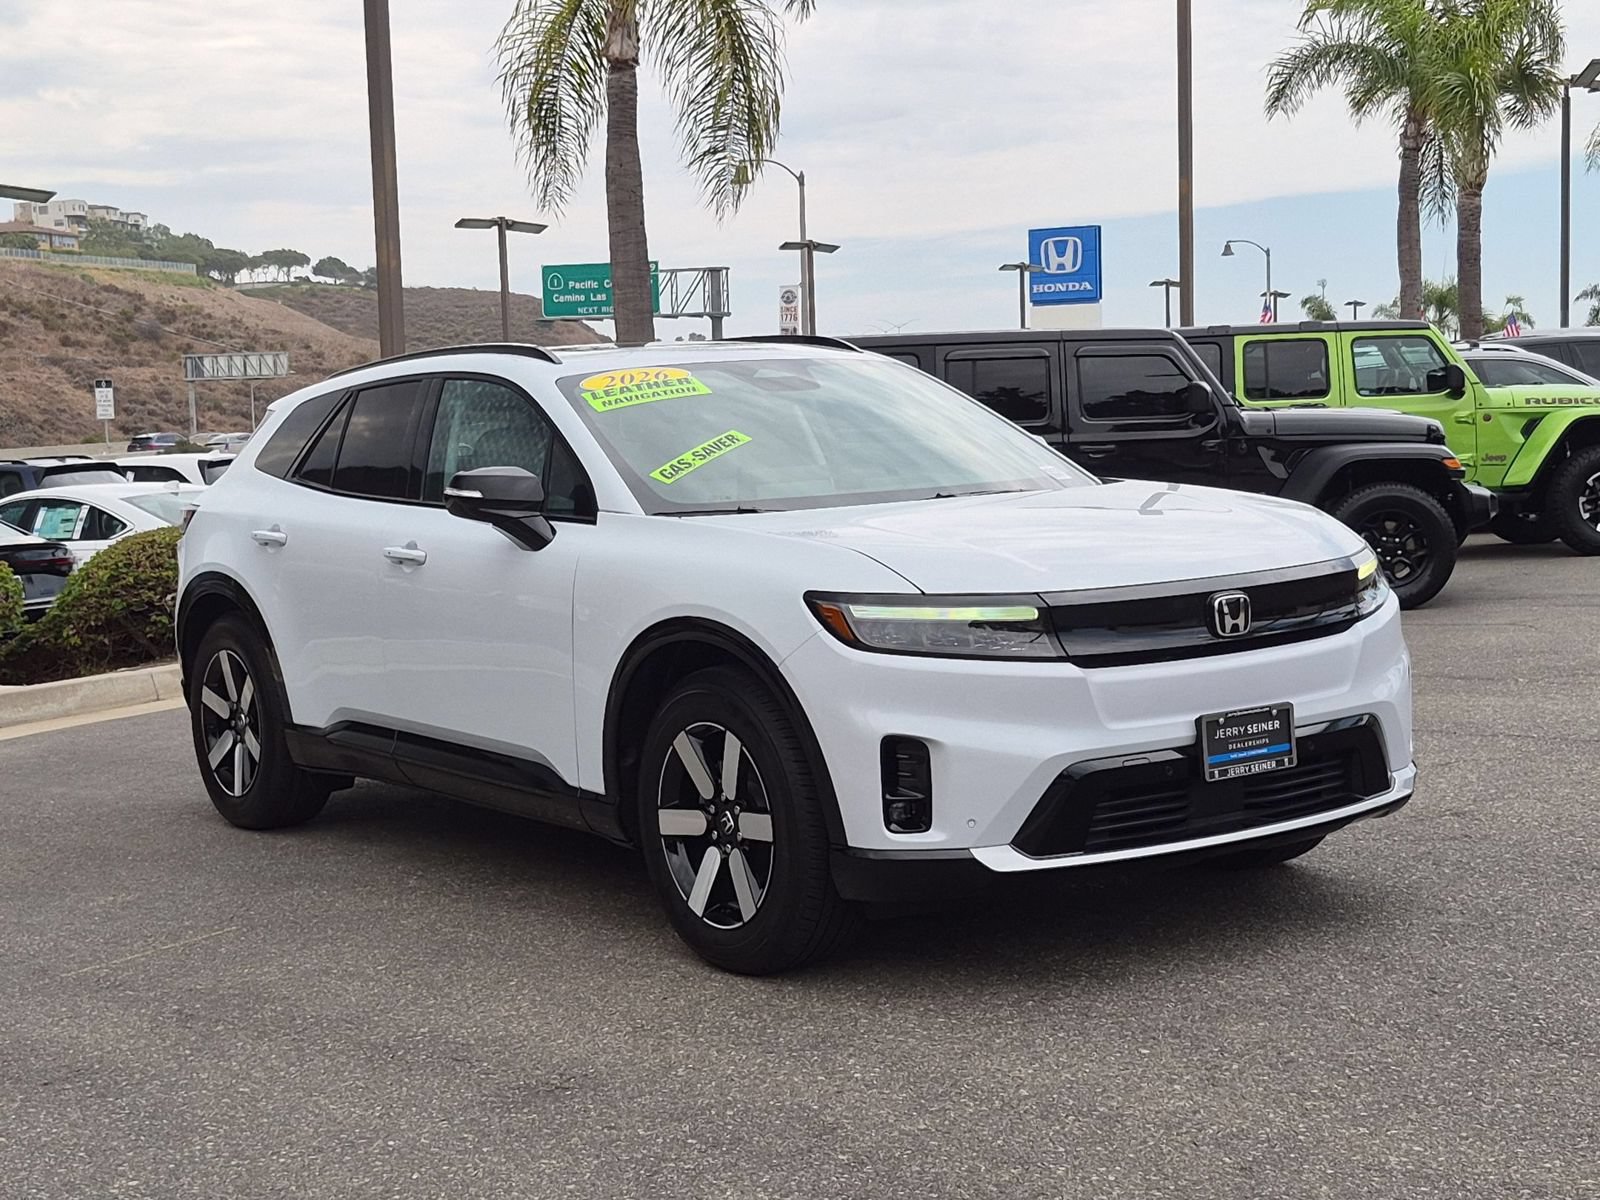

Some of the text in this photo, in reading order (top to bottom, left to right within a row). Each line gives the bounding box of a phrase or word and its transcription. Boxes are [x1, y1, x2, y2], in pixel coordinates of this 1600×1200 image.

[568, 280, 599, 289] Pacific
[1032, 281, 1093, 293] HONDA
[552, 293, 607, 303] Camino Las
[578, 305, 614, 314] NEXT RIG
[780, 313, 798, 322] 1776
[602, 369, 668, 388] 2026
[590, 377, 693, 400] LEATHER
[602, 386, 697, 408] NAVIGATION
[1481, 453, 1506, 463] Jeep
[1214, 720, 1280, 739] JERRY SEINER
[1228, 738, 1270, 750] DEALERSHIPS
[1227, 760, 1277, 777] JERRY SEINER
